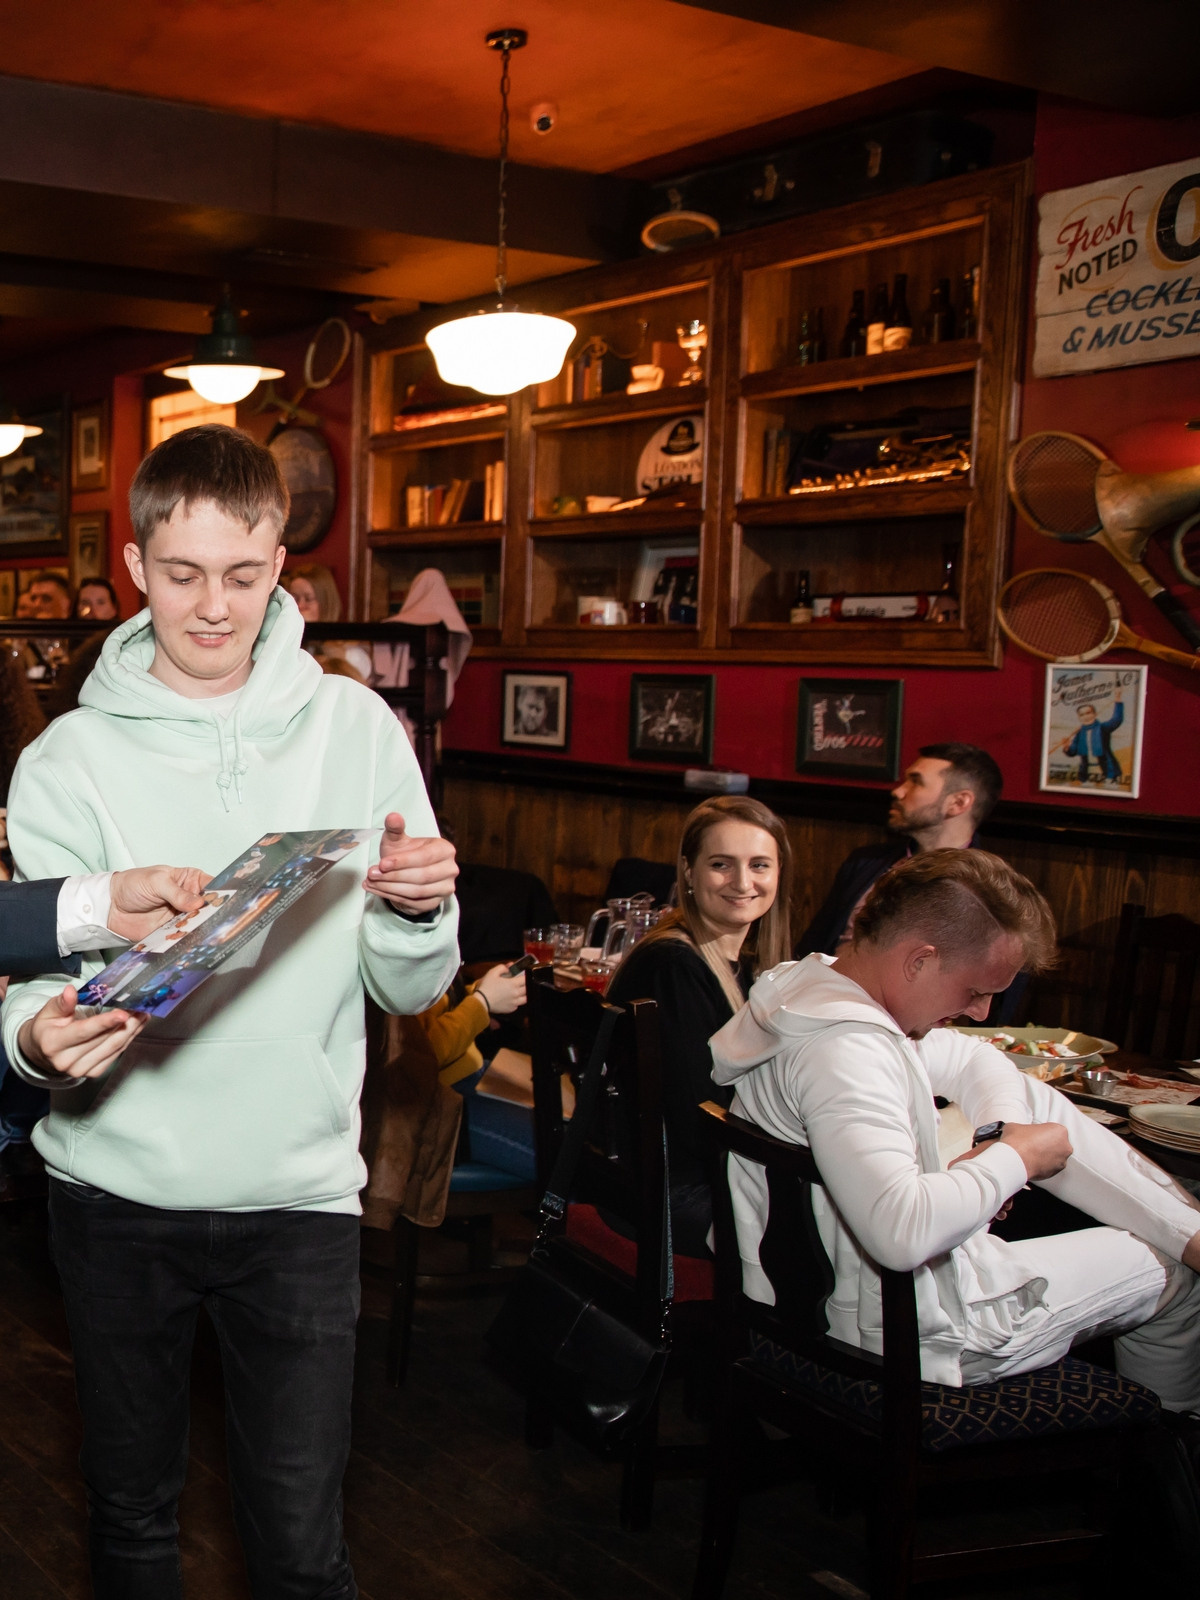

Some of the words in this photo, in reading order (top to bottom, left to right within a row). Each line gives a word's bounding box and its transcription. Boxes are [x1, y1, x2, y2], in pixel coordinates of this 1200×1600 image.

[1055, 185, 1143, 269] Fresh
[1058, 238, 1138, 295] NOTED
[1086, 276, 1200, 318] COCKL
[1062, 326, 1086, 354] &
